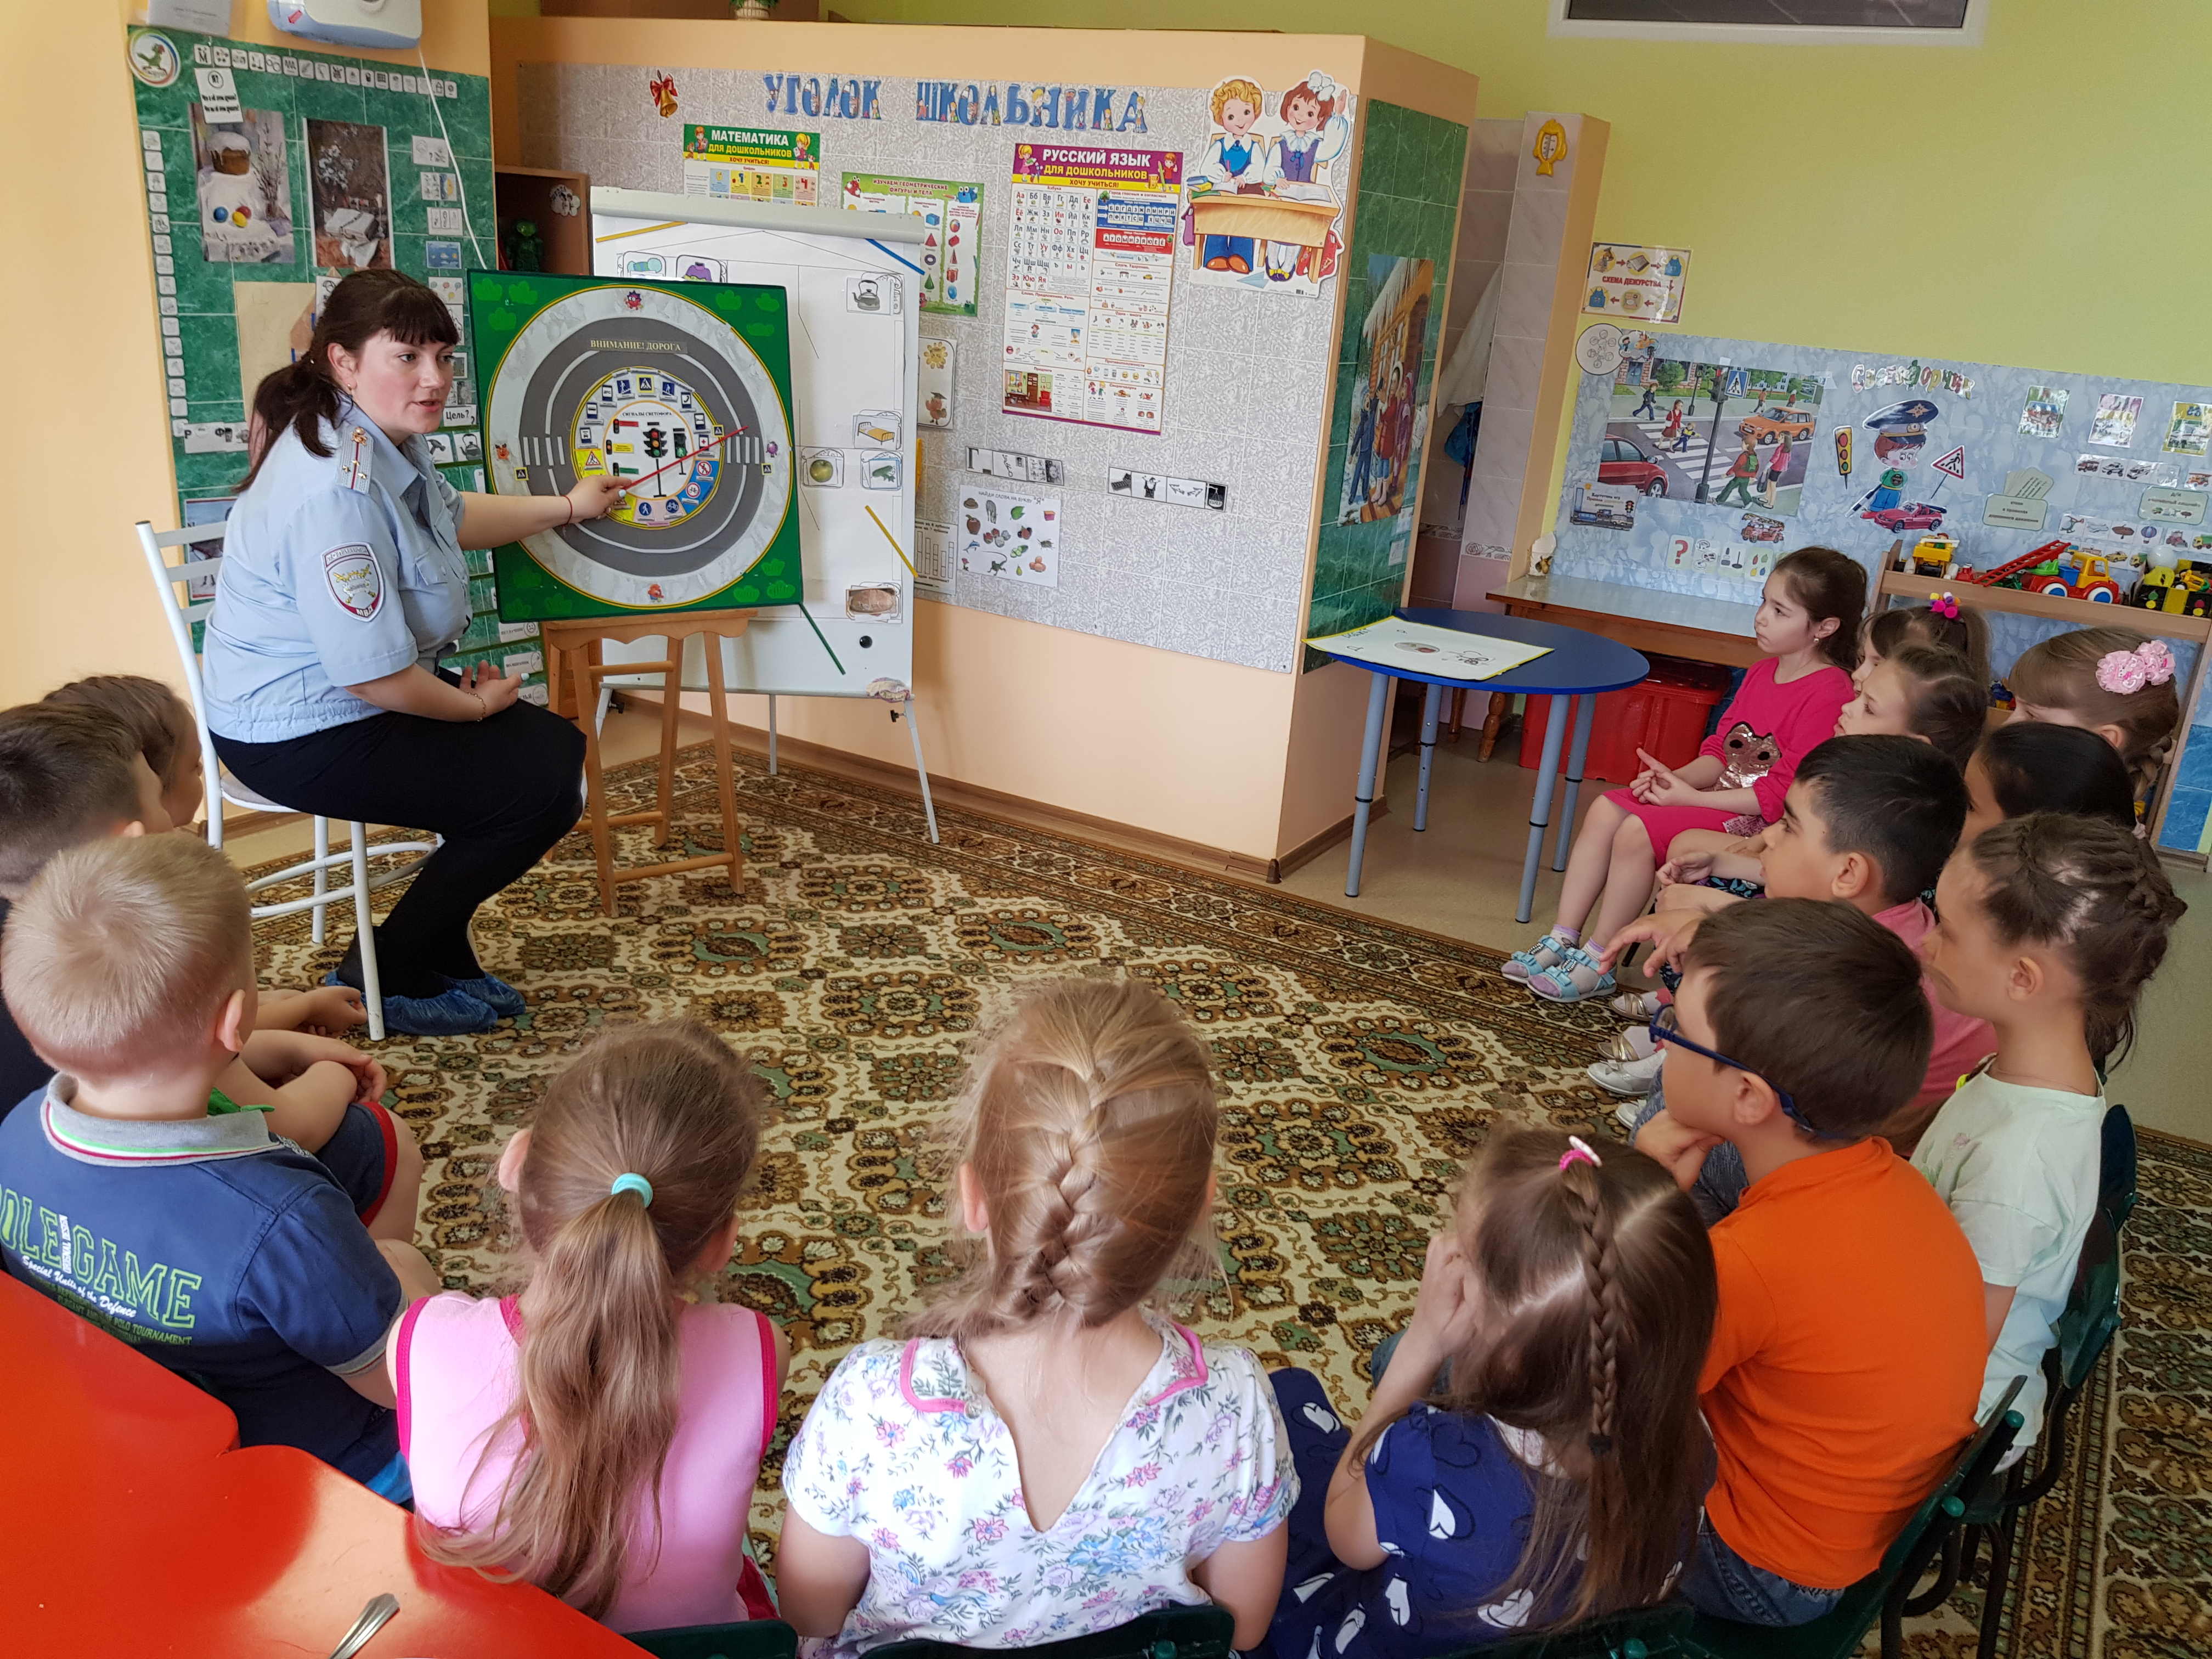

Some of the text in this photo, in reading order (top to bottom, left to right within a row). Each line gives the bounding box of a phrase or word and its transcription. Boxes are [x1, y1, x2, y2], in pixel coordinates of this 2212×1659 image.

[763, 74, 1148, 133] УГОЛОК ШКОЛЬНИКА
[711, 129, 789, 146] МАТЕМАТИКА
[708, 143, 792, 157] ДЛЯ ДОШКОЛЬНИКОВ
[1042, 149, 1151, 167] РУССКИЙ ЯЗЫК
[1043, 165, 1148, 179] ДЛЯ ДОШКОЛЬНИКОВ
[801, 178, 808, 189] 4
[899, 181, 948, 190] ГЕОМЕТРИЧЕСКИЕ
[1069, 179, 1119, 189] ХОЧУ УЧИТЬСЯ!
[1069, 195, 1079, 204] Дд
[1068, 212, 1077, 220] Йй
[1081, 230, 1089, 238] Рр
[1040, 243, 1048, 251] Уу
[1052, 244, 1063, 253] Фф
[1080, 247, 1089, 255] Цц
[1037, 259, 1049, 267] Щщ
[1602, 276, 1661, 287] СХЕМА ДЕЖУРСТВА
[590, 340, 681, 351] ВНИМАНИЕ! ДОРОГА
[356, 605, 374, 617] МВД
[0, 1183, 62, 1269] OLE
[21, 1255, 53, 1279] Special
[53, 1269, 77, 1289] Units
[77, 1285, 86, 1299] of
[86, 1289, 98, 1304] the
[99, 1295, 137, 1318] Defence
[133, 1323, 192, 1345] TOURNAMENT
